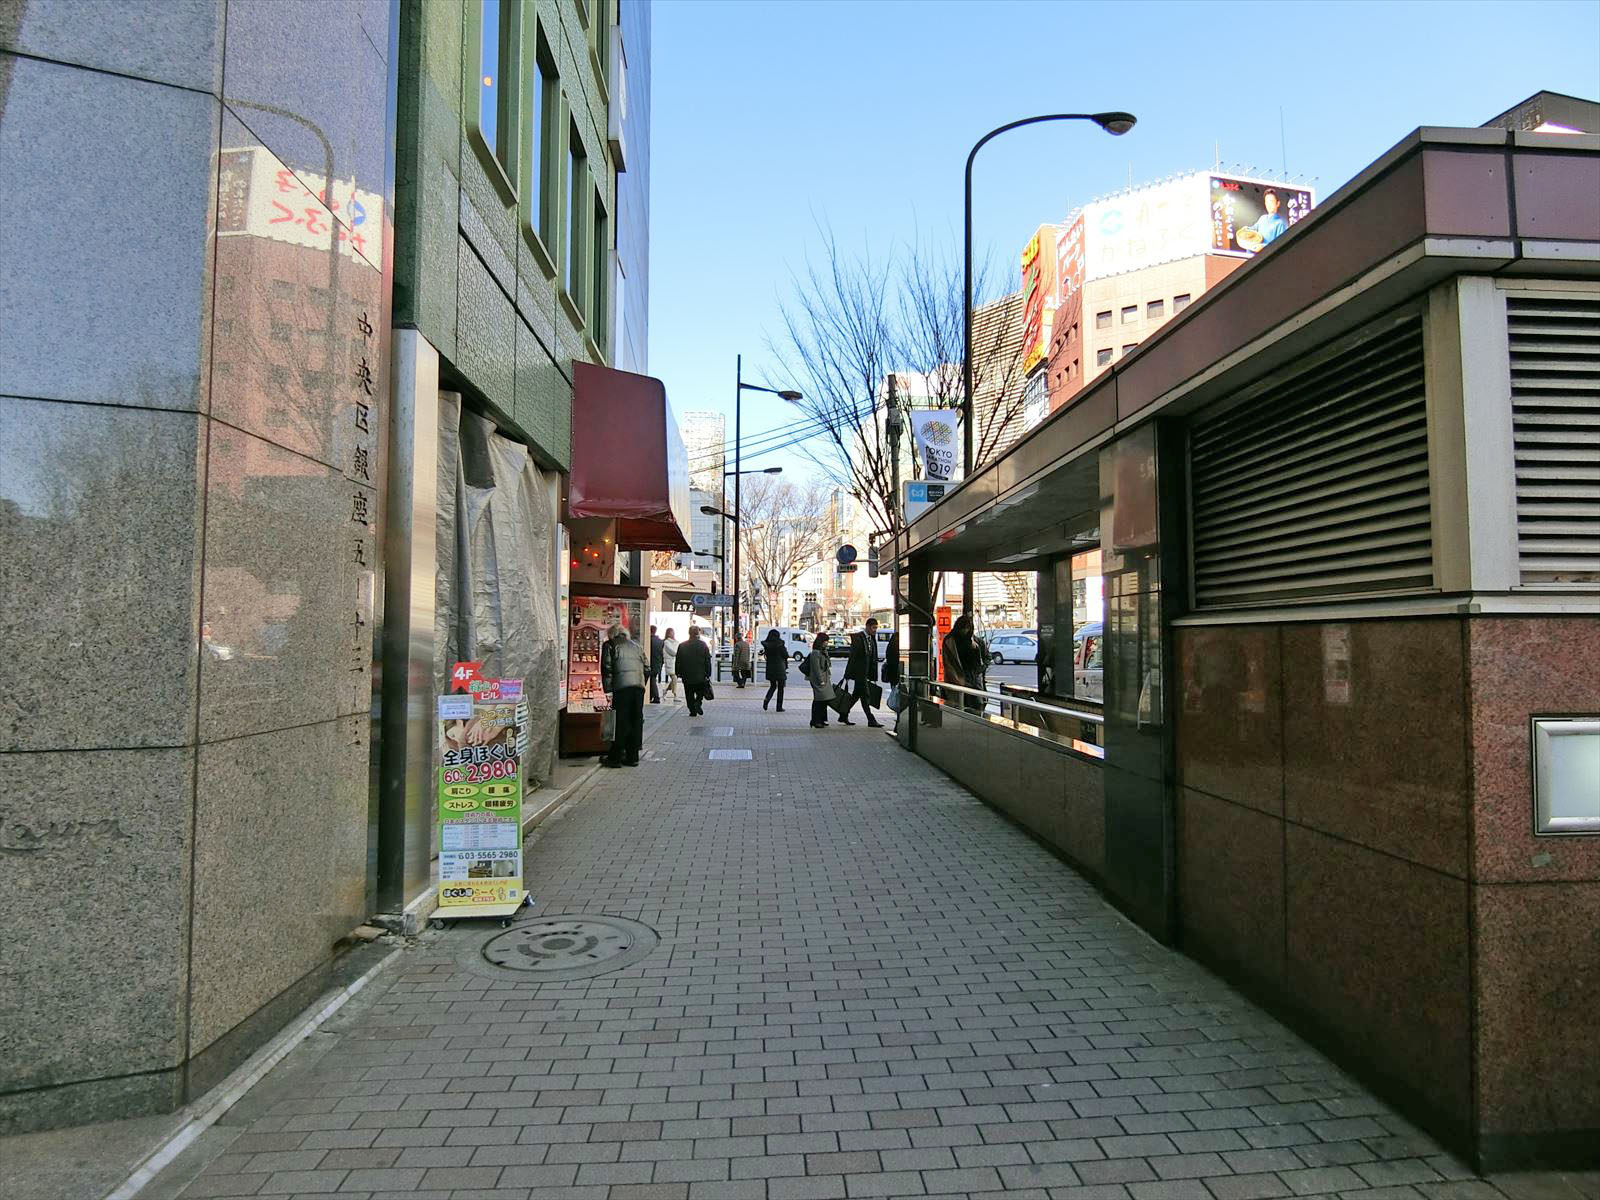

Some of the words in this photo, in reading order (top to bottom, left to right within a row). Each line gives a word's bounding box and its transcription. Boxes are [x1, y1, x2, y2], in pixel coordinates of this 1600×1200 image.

[454, 666, 474, 680] 4F
[481, 691, 500, 700] ビル
[443, 743, 516, 767] 全身ほぐし
[451, 787, 472, 795] 肩こり
[449, 801, 475, 809] ストレス
